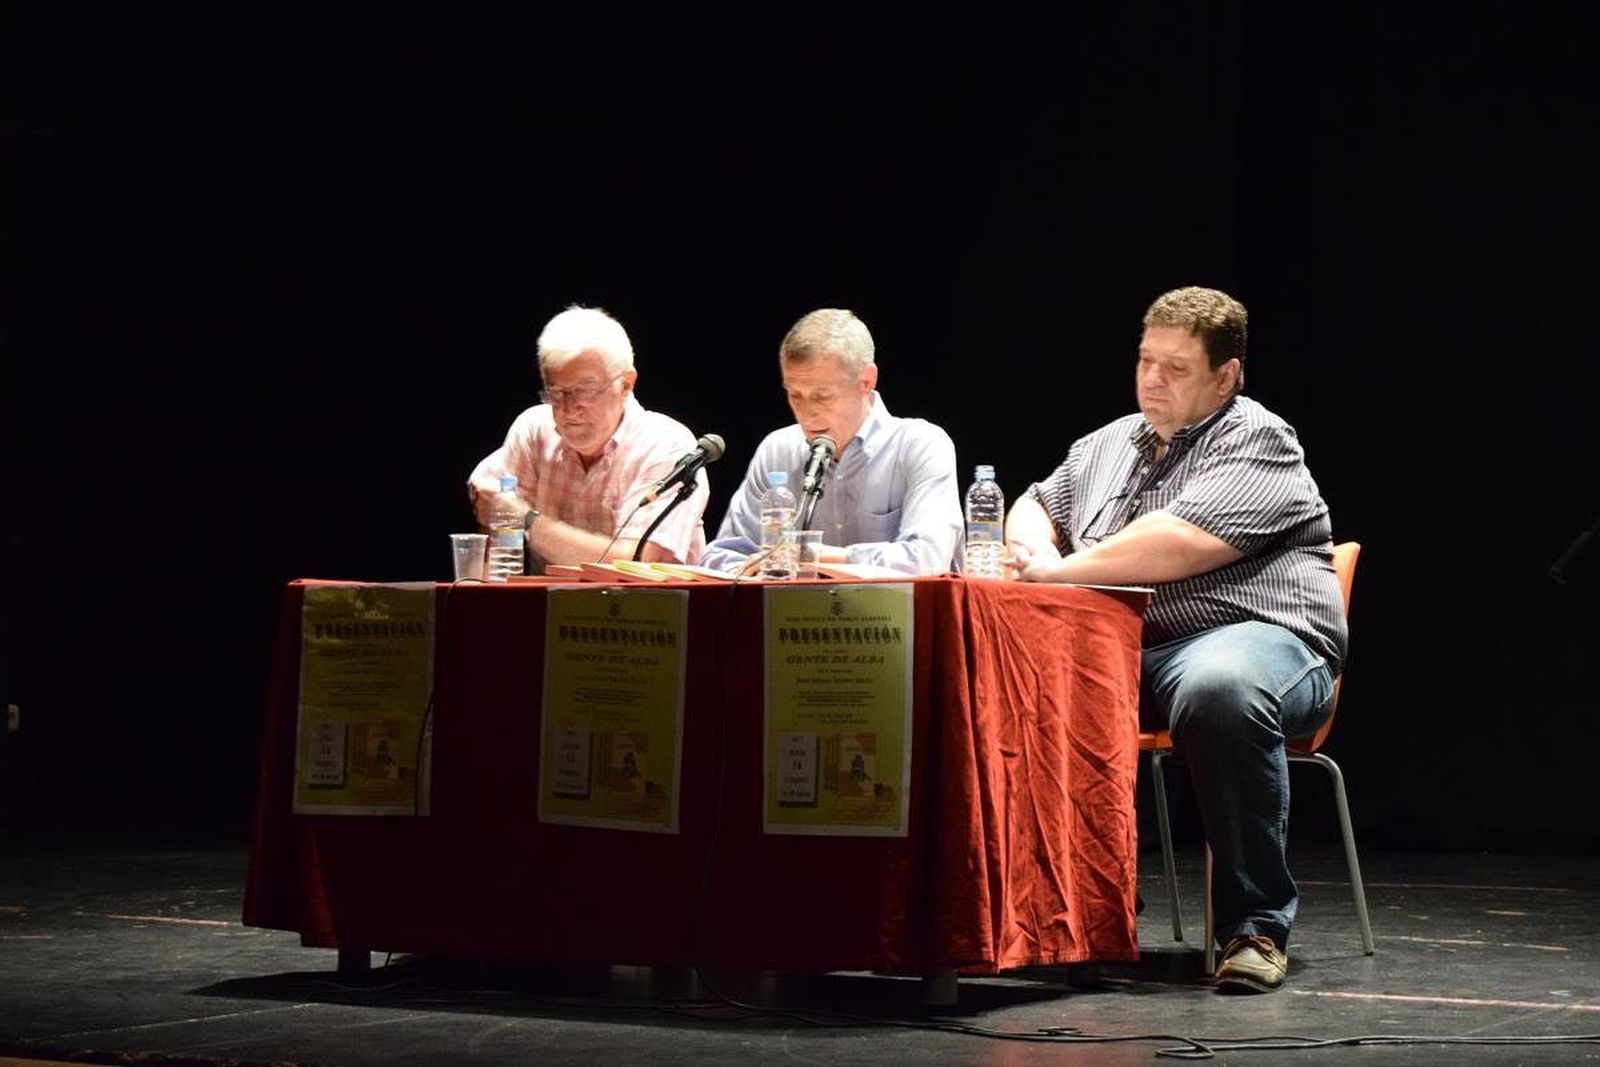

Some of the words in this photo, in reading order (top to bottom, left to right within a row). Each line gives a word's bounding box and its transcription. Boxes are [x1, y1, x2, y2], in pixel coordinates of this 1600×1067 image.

[778, 624, 902, 644] PRESENTACIÓN
[786, 655, 828, 664] GENTE
[831, 655, 850, 664] DE
[852, 655, 885, 664] ALBA
